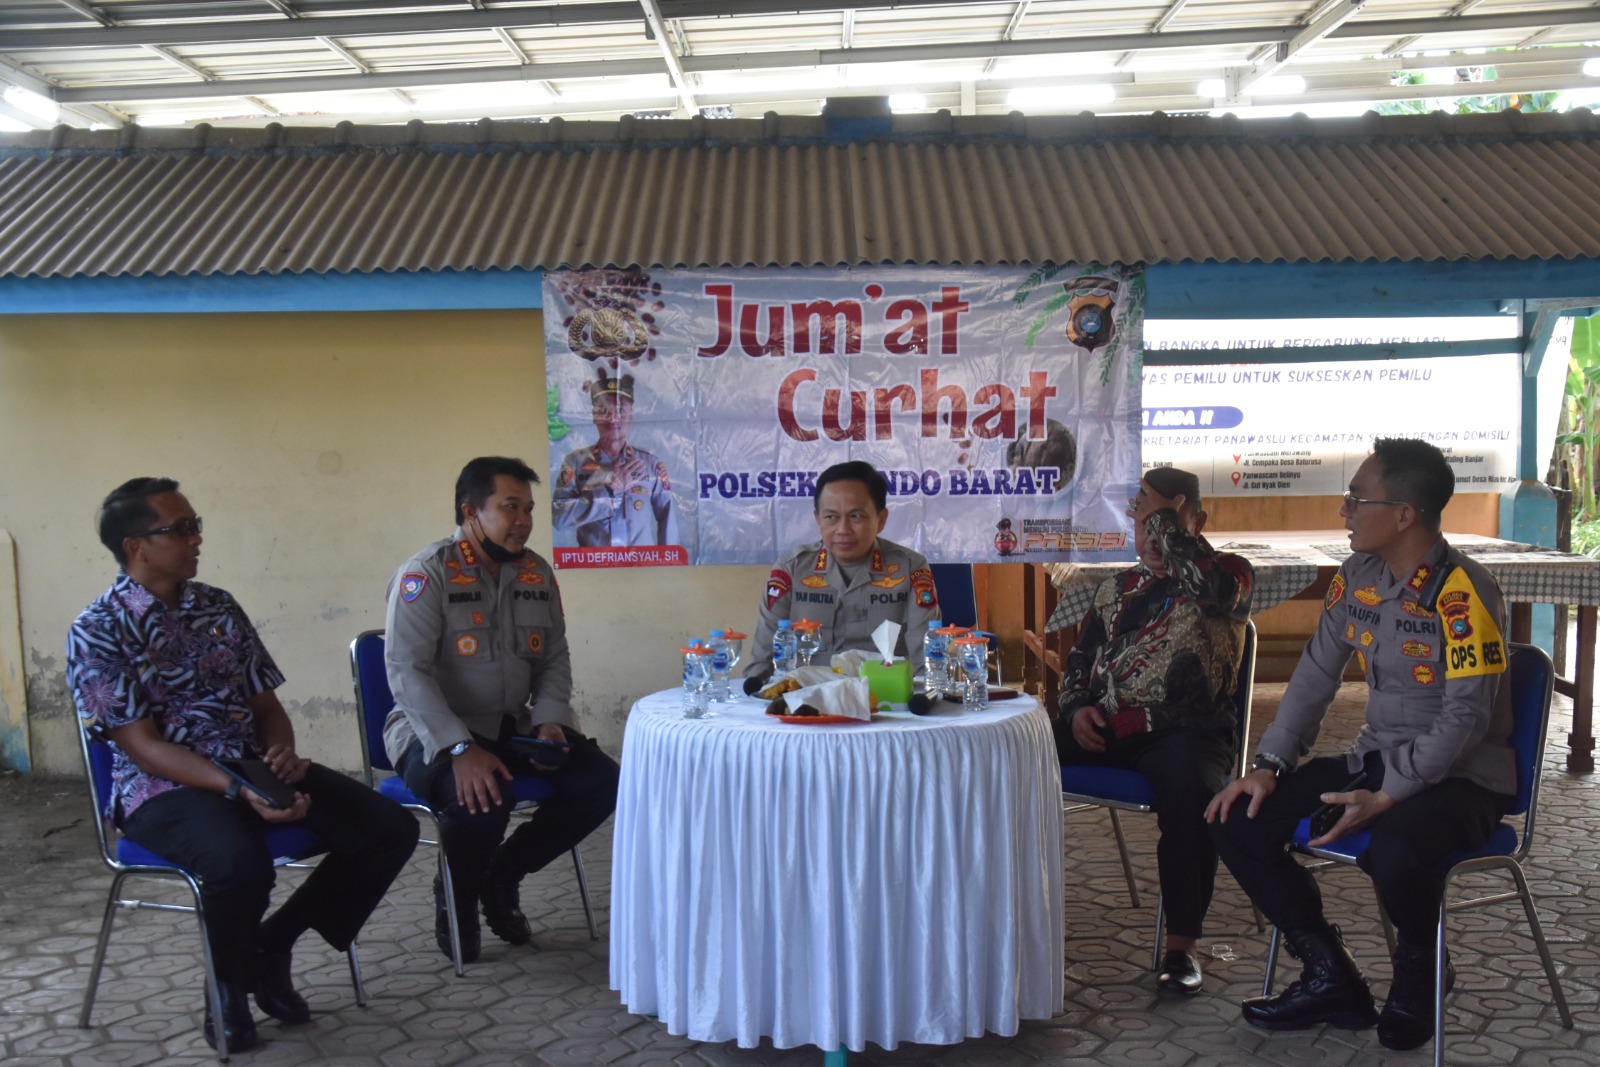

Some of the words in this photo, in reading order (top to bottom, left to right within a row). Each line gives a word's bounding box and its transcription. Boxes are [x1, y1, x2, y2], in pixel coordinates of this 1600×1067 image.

[698, 284, 969, 357] Jum'at
[1174, 372, 1226, 384] PEMILU
[1233, 371, 1281, 383] UNTUK
[1288, 369, 1372, 383] SUKSESKAN
[1379, 368, 1432, 381] PEMILU
[777, 368, 1057, 442] Curhat
[1215, 434, 1286, 445] PANAWASLU
[1291, 433, 1363, 444] KECAMATAN
[1463, 430, 1511, 441] DOMISILI
[1252, 459, 1279, 467] Cempaka
[699, 472, 818, 499] POLSEK
[949, 466, 1060, 496] BARAT
[1262, 482, 1276, 490] Nyak
[1024, 533, 1127, 548] PRESISI
[562, 553, 584, 563] IPTU
[664, 550, 679, 561] SH
[514, 590, 549, 602] POLRI
[809, 593, 834, 605] SULTRA
[870, 591, 907, 605] POLRI
[1396, 619, 1436, 634] POLRI
[1451, 643, 1477, 670] OPS
